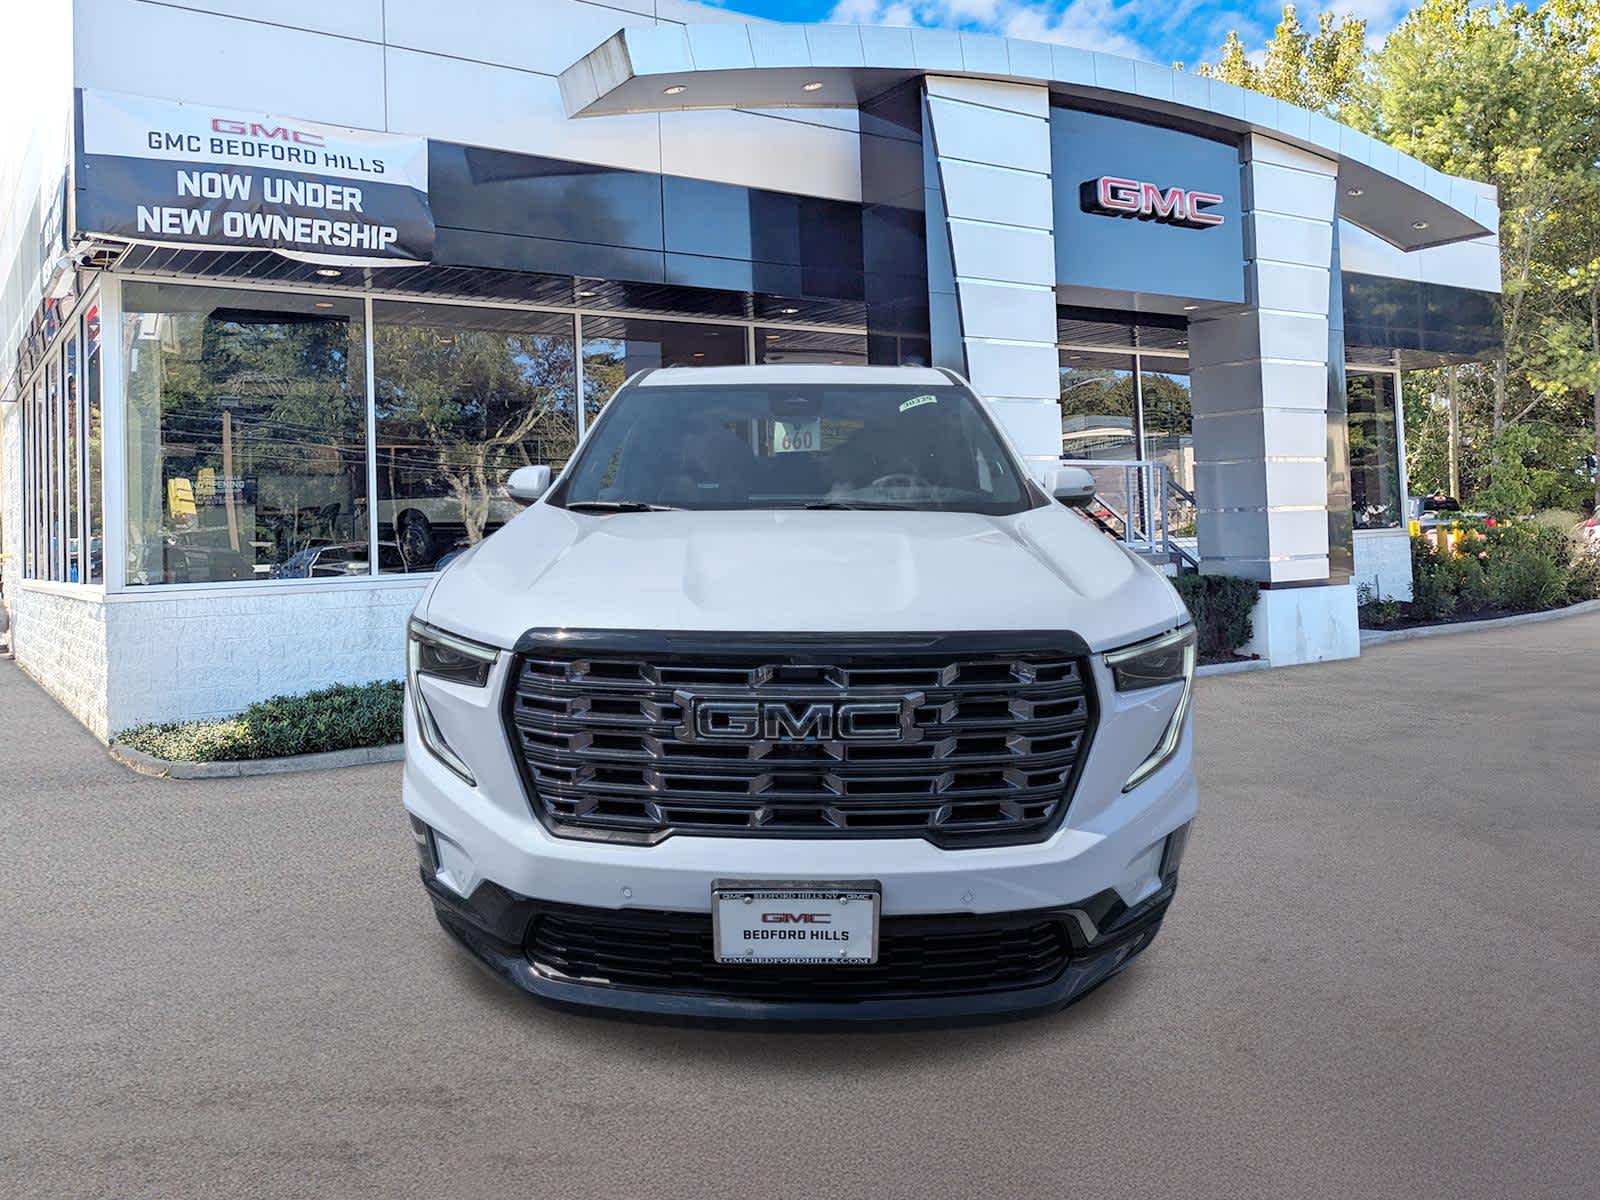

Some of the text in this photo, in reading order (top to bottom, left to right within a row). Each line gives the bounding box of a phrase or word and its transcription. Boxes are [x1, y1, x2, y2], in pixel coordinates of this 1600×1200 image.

[148, 131, 385, 174] GMC BEDFORD HILLS
[211, 117, 326, 148] GMC
[177, 170, 362, 213] NOW UNDER
[1097, 176, 1225, 224] GMC
[137, 205, 398, 250] NEW OWNERSHIP
[697, 703, 902, 740] GMC
[743, 930, 849, 941] BEDFORD HILLS
[761, 913, 832, 924] GMC
